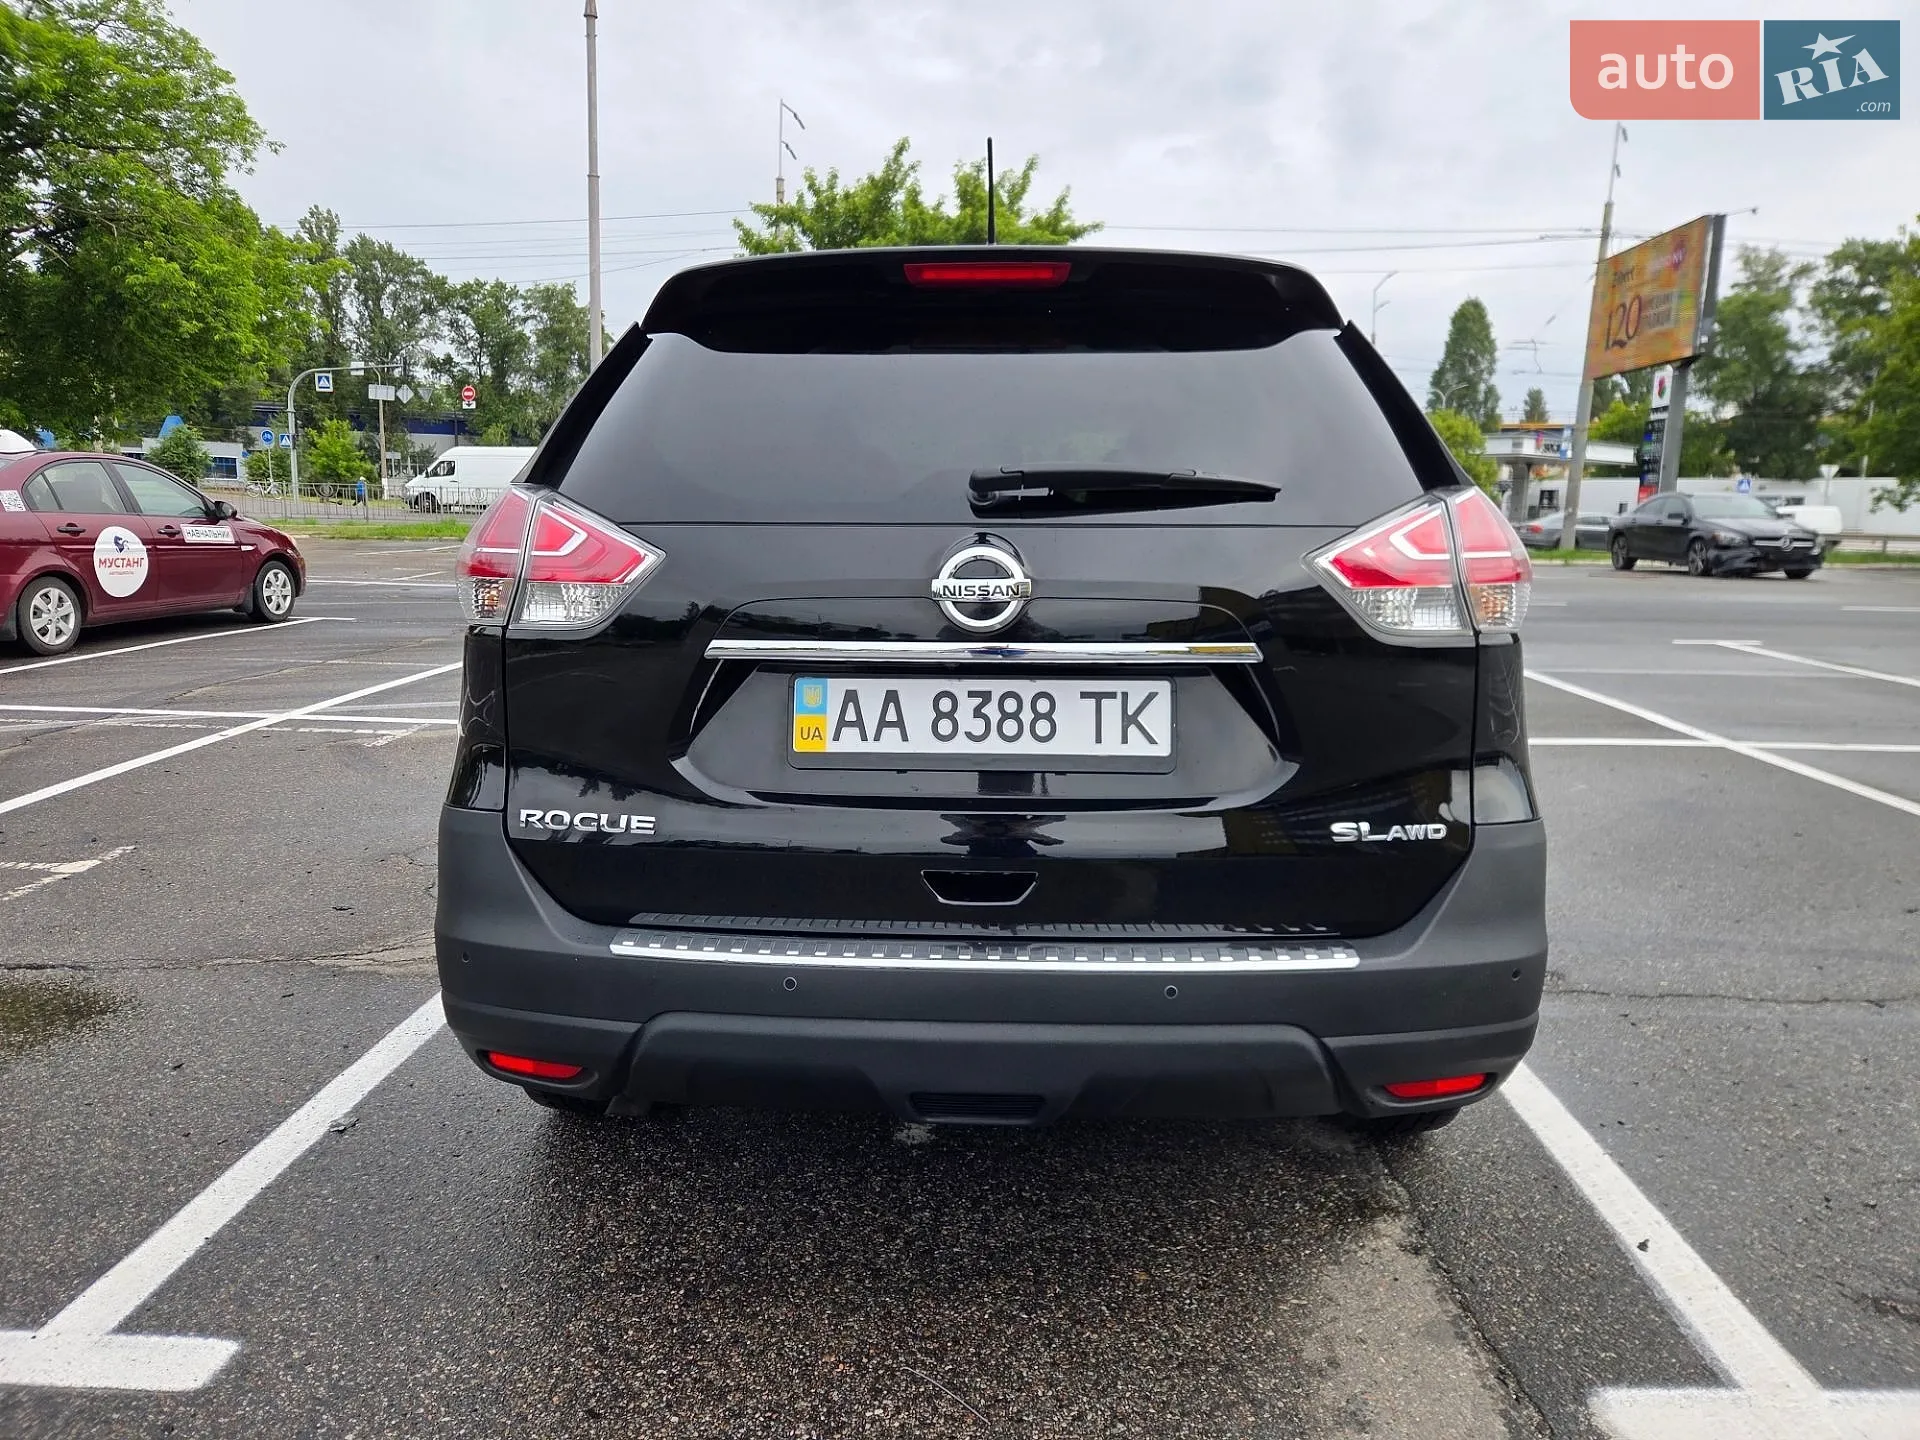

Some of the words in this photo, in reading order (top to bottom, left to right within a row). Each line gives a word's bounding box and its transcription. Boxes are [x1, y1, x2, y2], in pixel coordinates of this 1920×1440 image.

[98, 557, 145, 569] МУСТАНГ
[942, 582, 1020, 598] NISSAN
[832, 688, 909, 742] AA
[930, 690, 1058, 743] 8388
[1080, 691, 1160, 745] TK
[799, 726, 824, 741] UA
[519, 809, 657, 836] ROGUE
